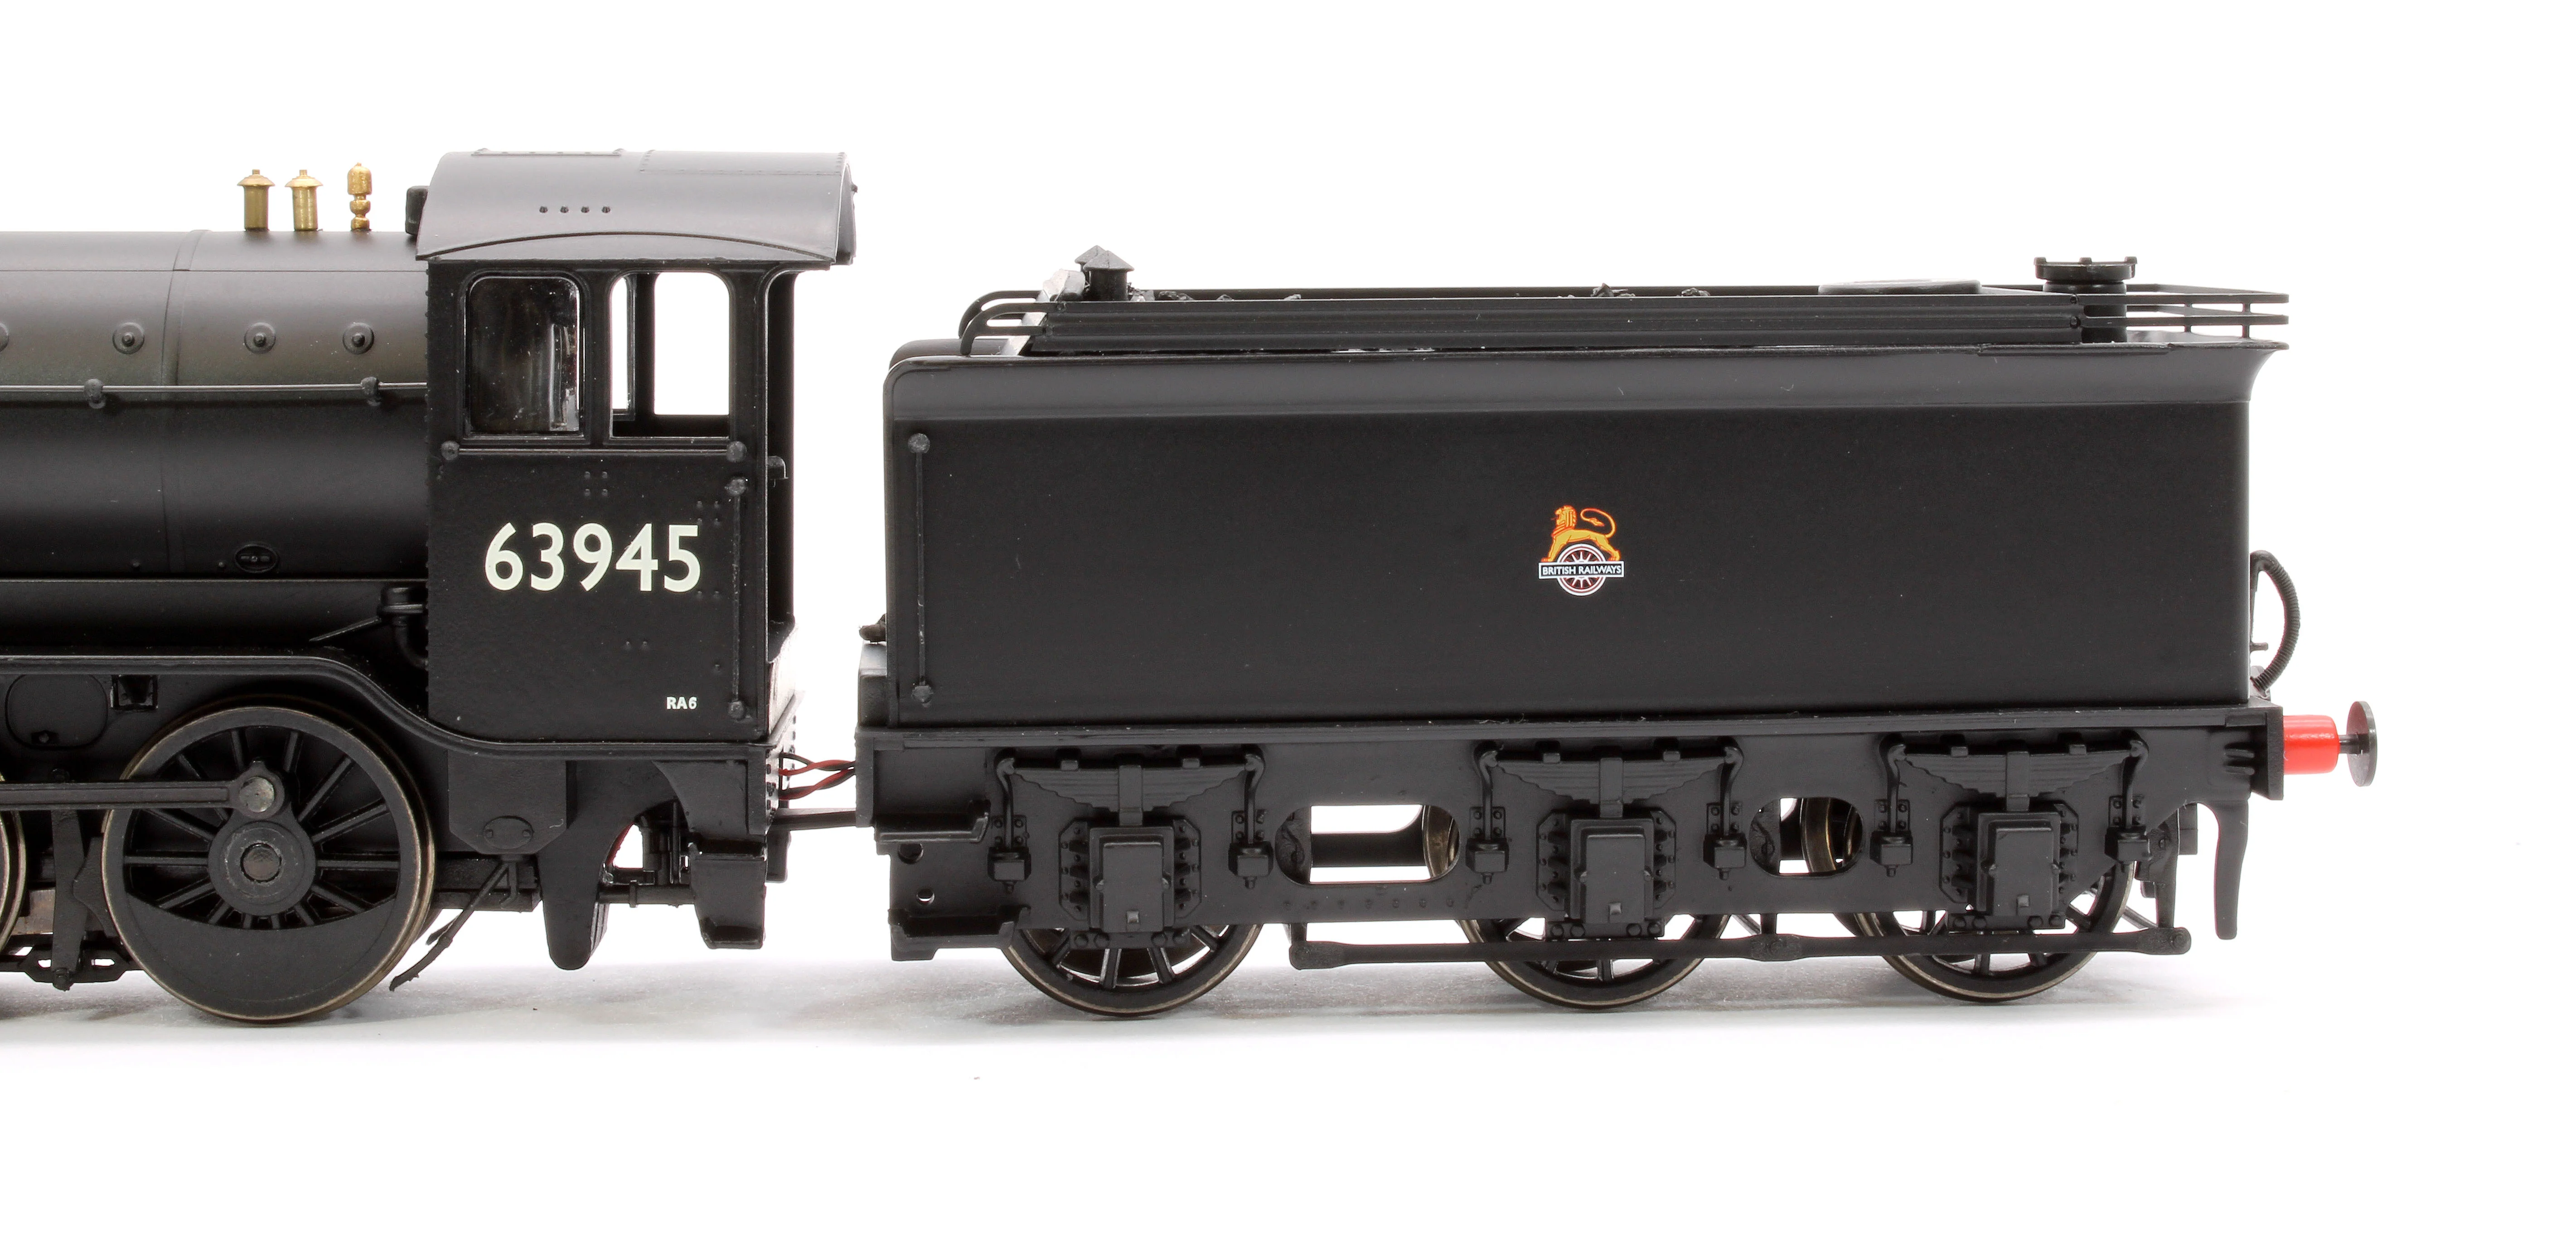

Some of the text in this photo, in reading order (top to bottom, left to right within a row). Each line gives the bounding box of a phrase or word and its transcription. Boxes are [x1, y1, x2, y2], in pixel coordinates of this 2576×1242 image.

[484, 522, 701, 593] 63945
[1542, 565, 1622, 575] BRITISH RAILWAYS
[666, 696, 697, 710] RA6
